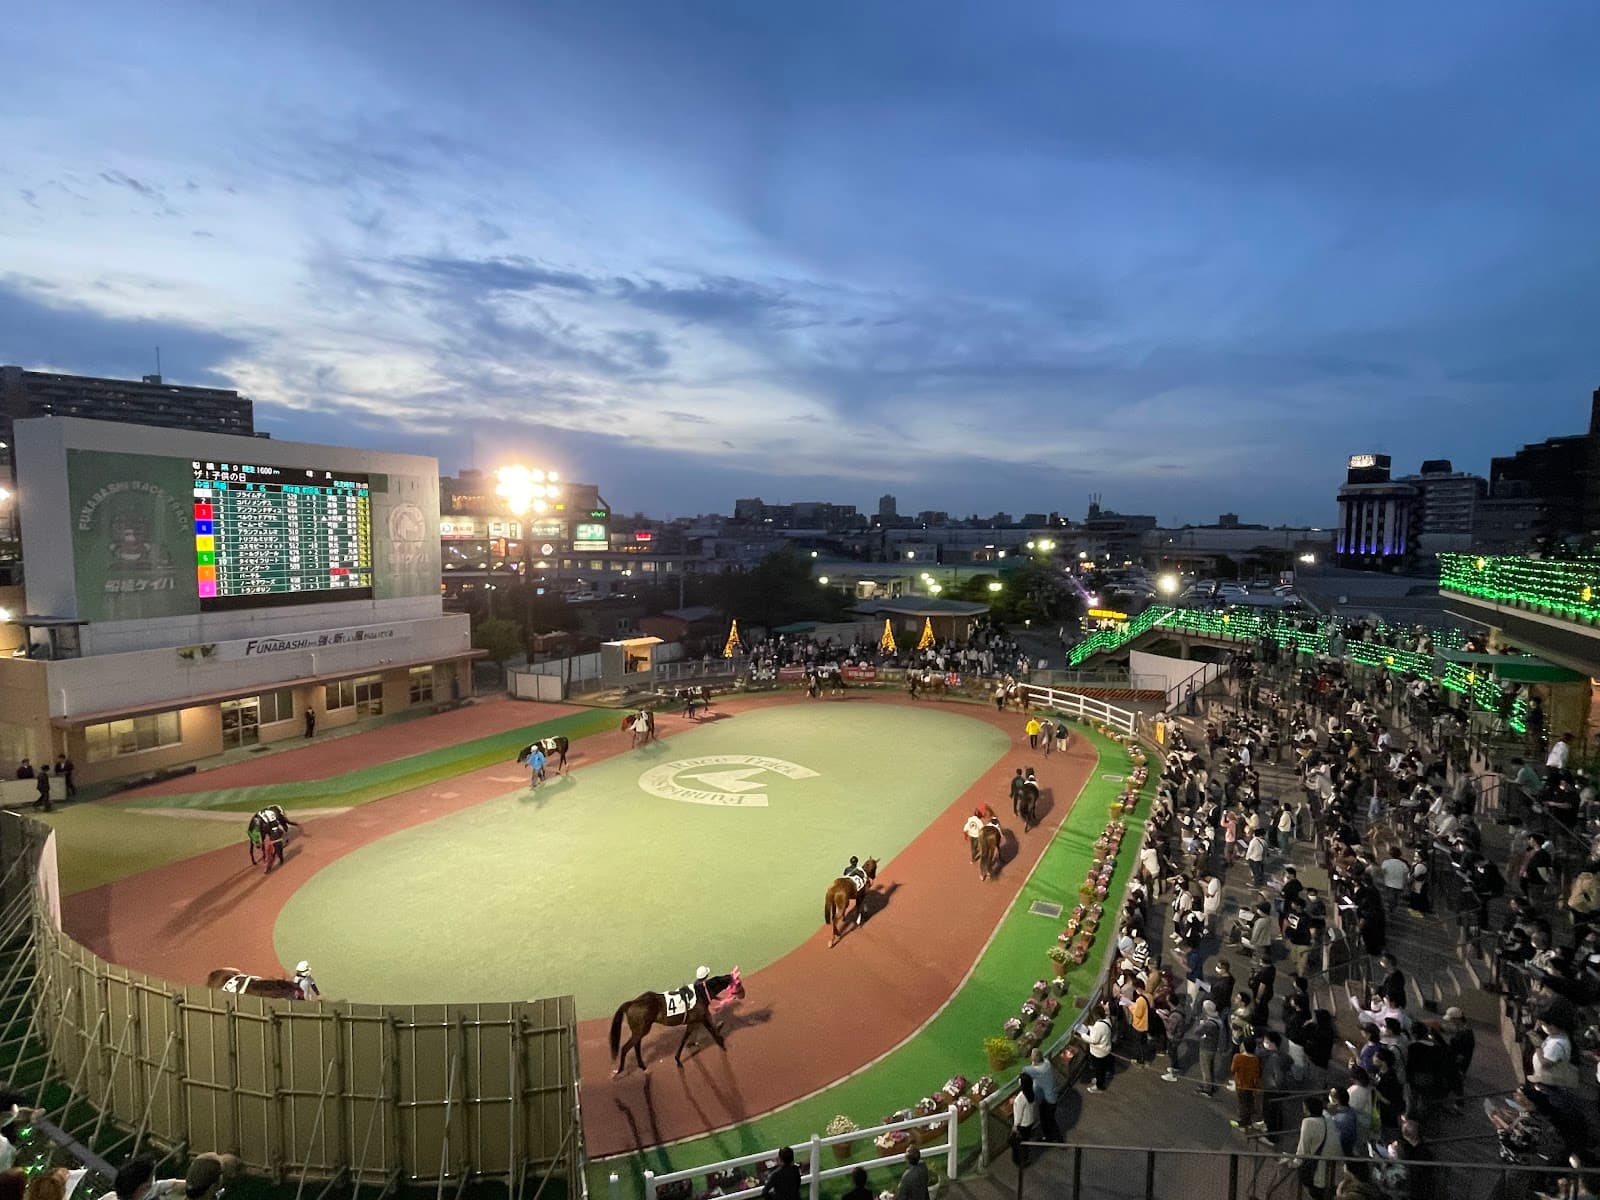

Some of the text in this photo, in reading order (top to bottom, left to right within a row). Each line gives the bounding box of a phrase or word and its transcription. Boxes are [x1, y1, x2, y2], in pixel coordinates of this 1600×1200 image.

[79, 480, 129, 531] FUNABASHI
[246, 640, 308, 656] FUNABASHI
[668, 998, 677, 1014] 4
